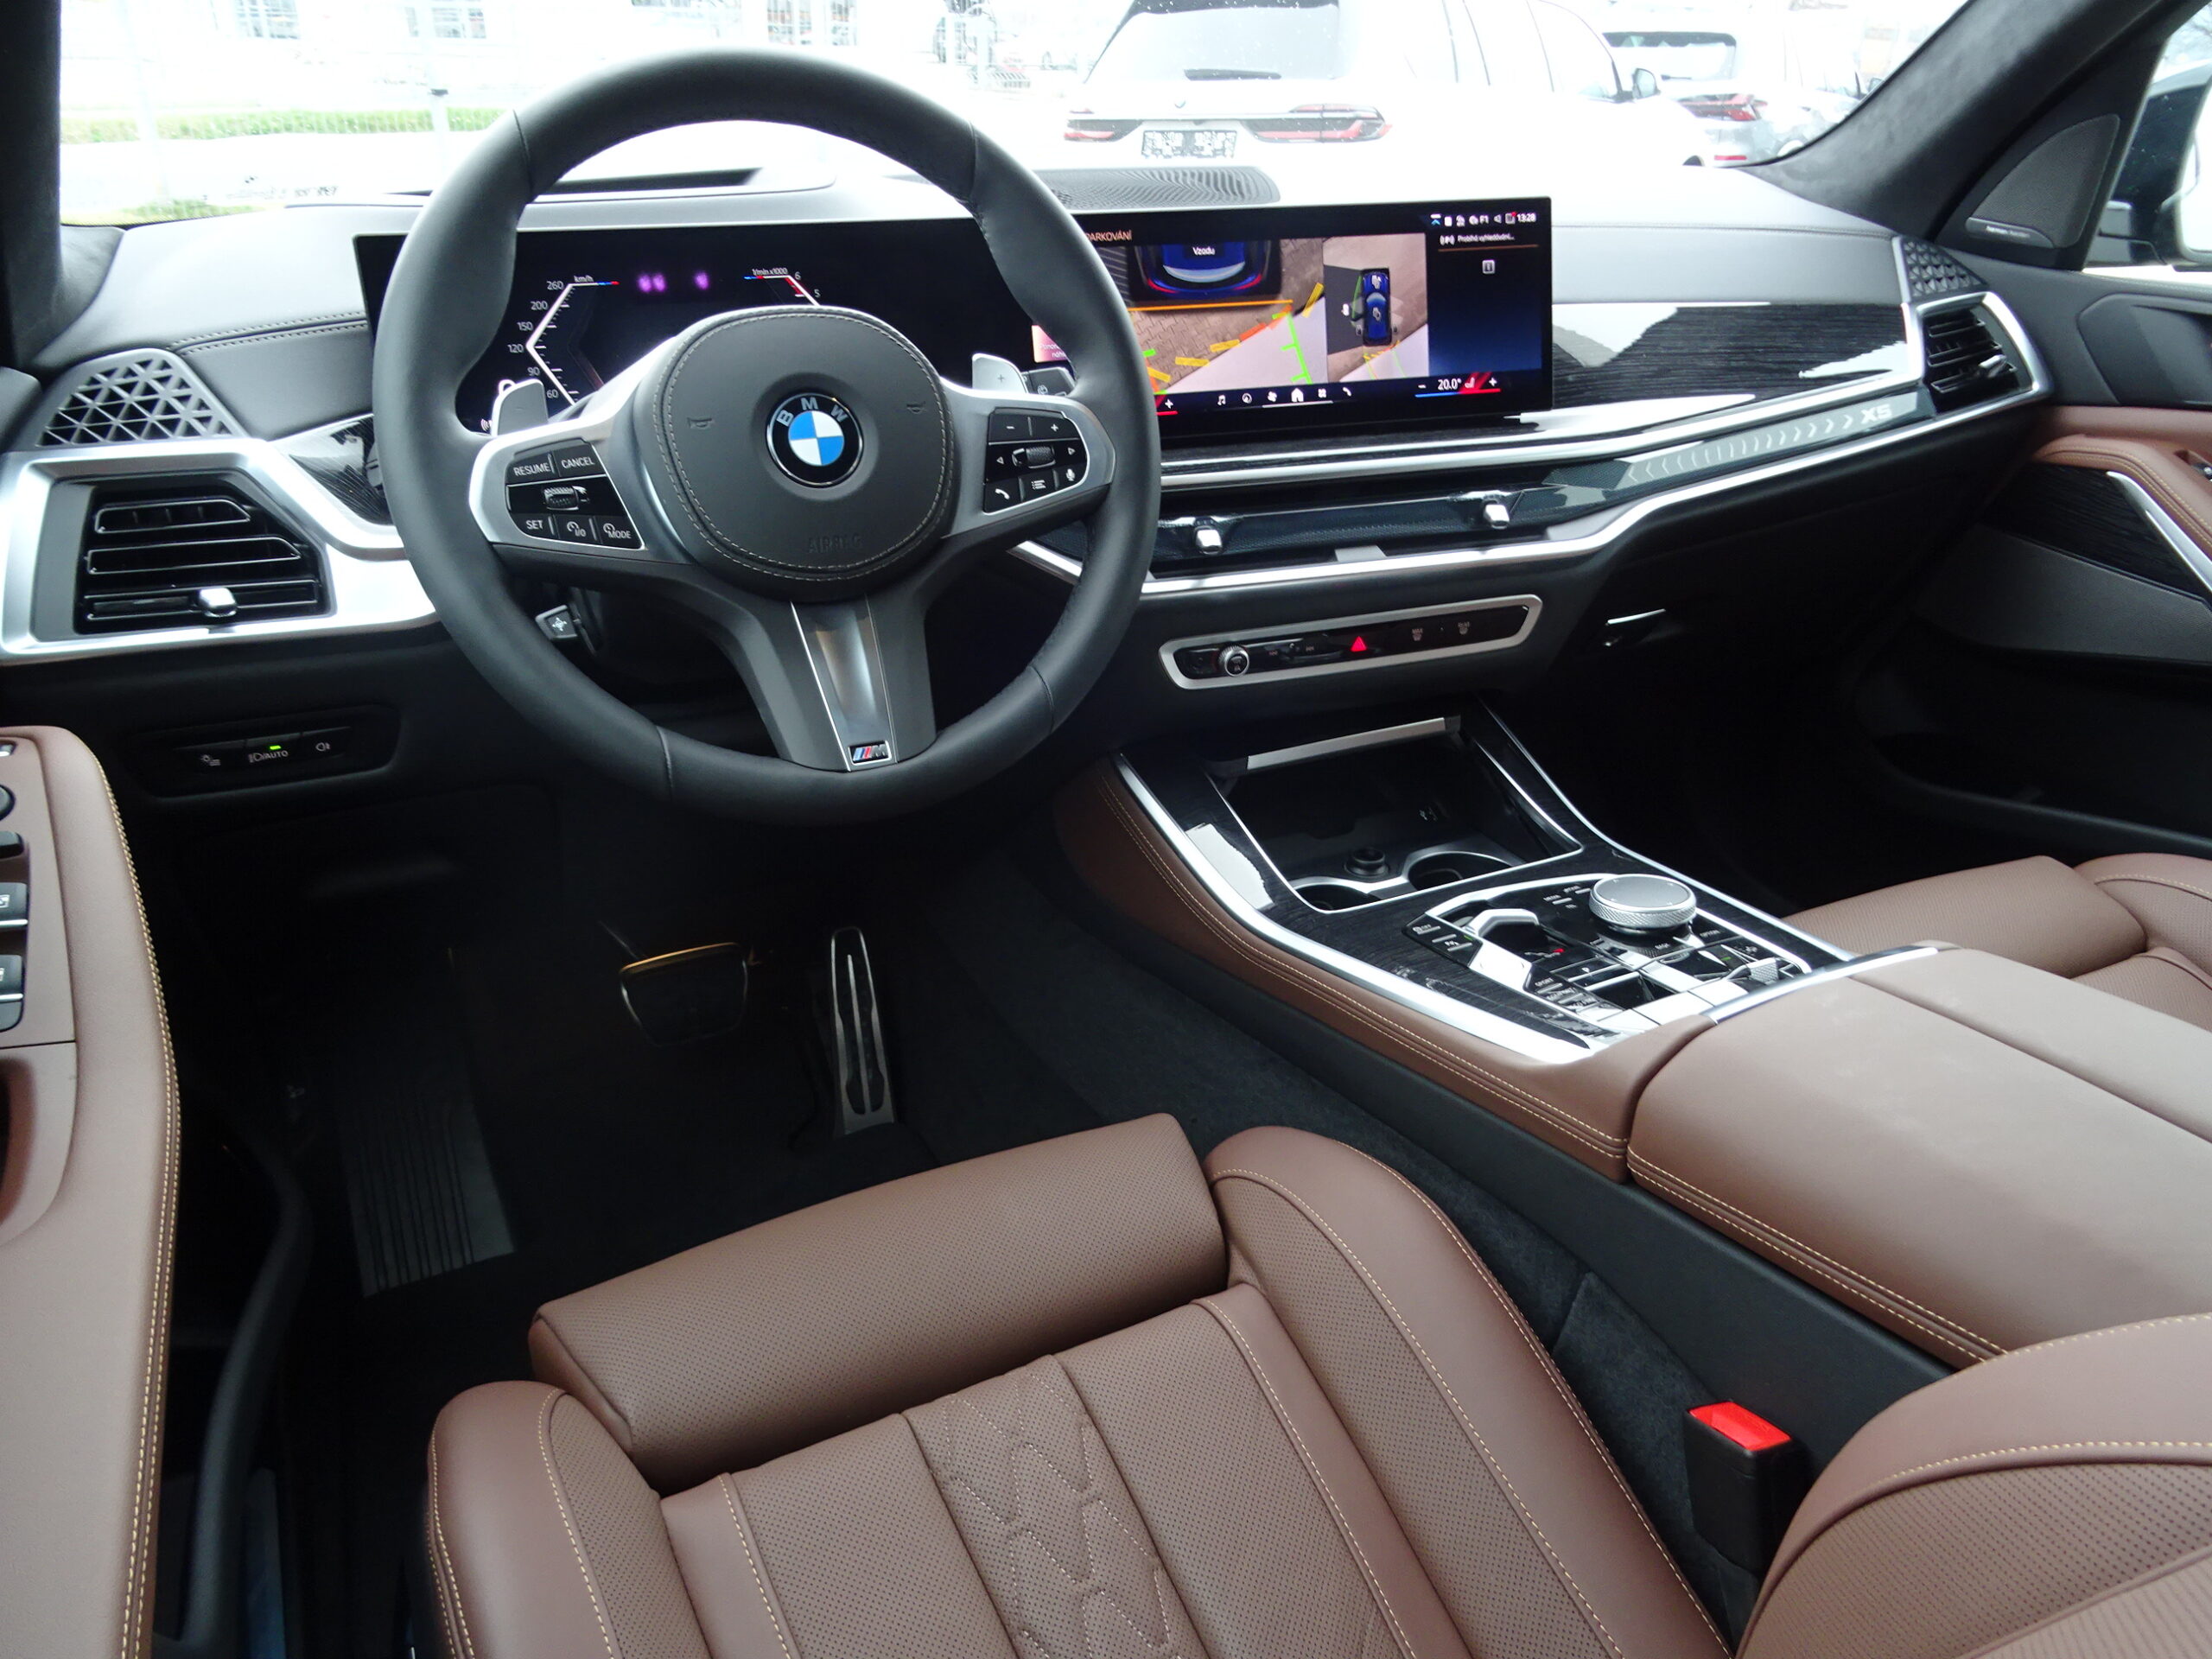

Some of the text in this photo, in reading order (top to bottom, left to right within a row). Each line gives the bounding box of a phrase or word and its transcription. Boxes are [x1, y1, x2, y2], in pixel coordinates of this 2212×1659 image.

[1516, 213, 1536, 222] 13:28
[574, 275, 594, 283] km/h
[794, 271, 802, 280] 6
[546, 280, 563, 290] 260
[814, 289, 821, 298] 5
[531, 301, 549, 311] 200
[517, 321, 534, 331] 150
[507, 344, 524, 353] 120
[527, 366, 540, 377] 90
[546, 389, 559, 398] 60
[776, 397, 849, 427] BMW
[1860, 404, 1892, 425] X5
[561, 456, 595, 469] CANCEL
[513, 462, 550, 476] RESUME
[525, 519, 544, 530] SET
[607, 530, 632, 539] MODE
[265, 750, 289, 760] AUTO
